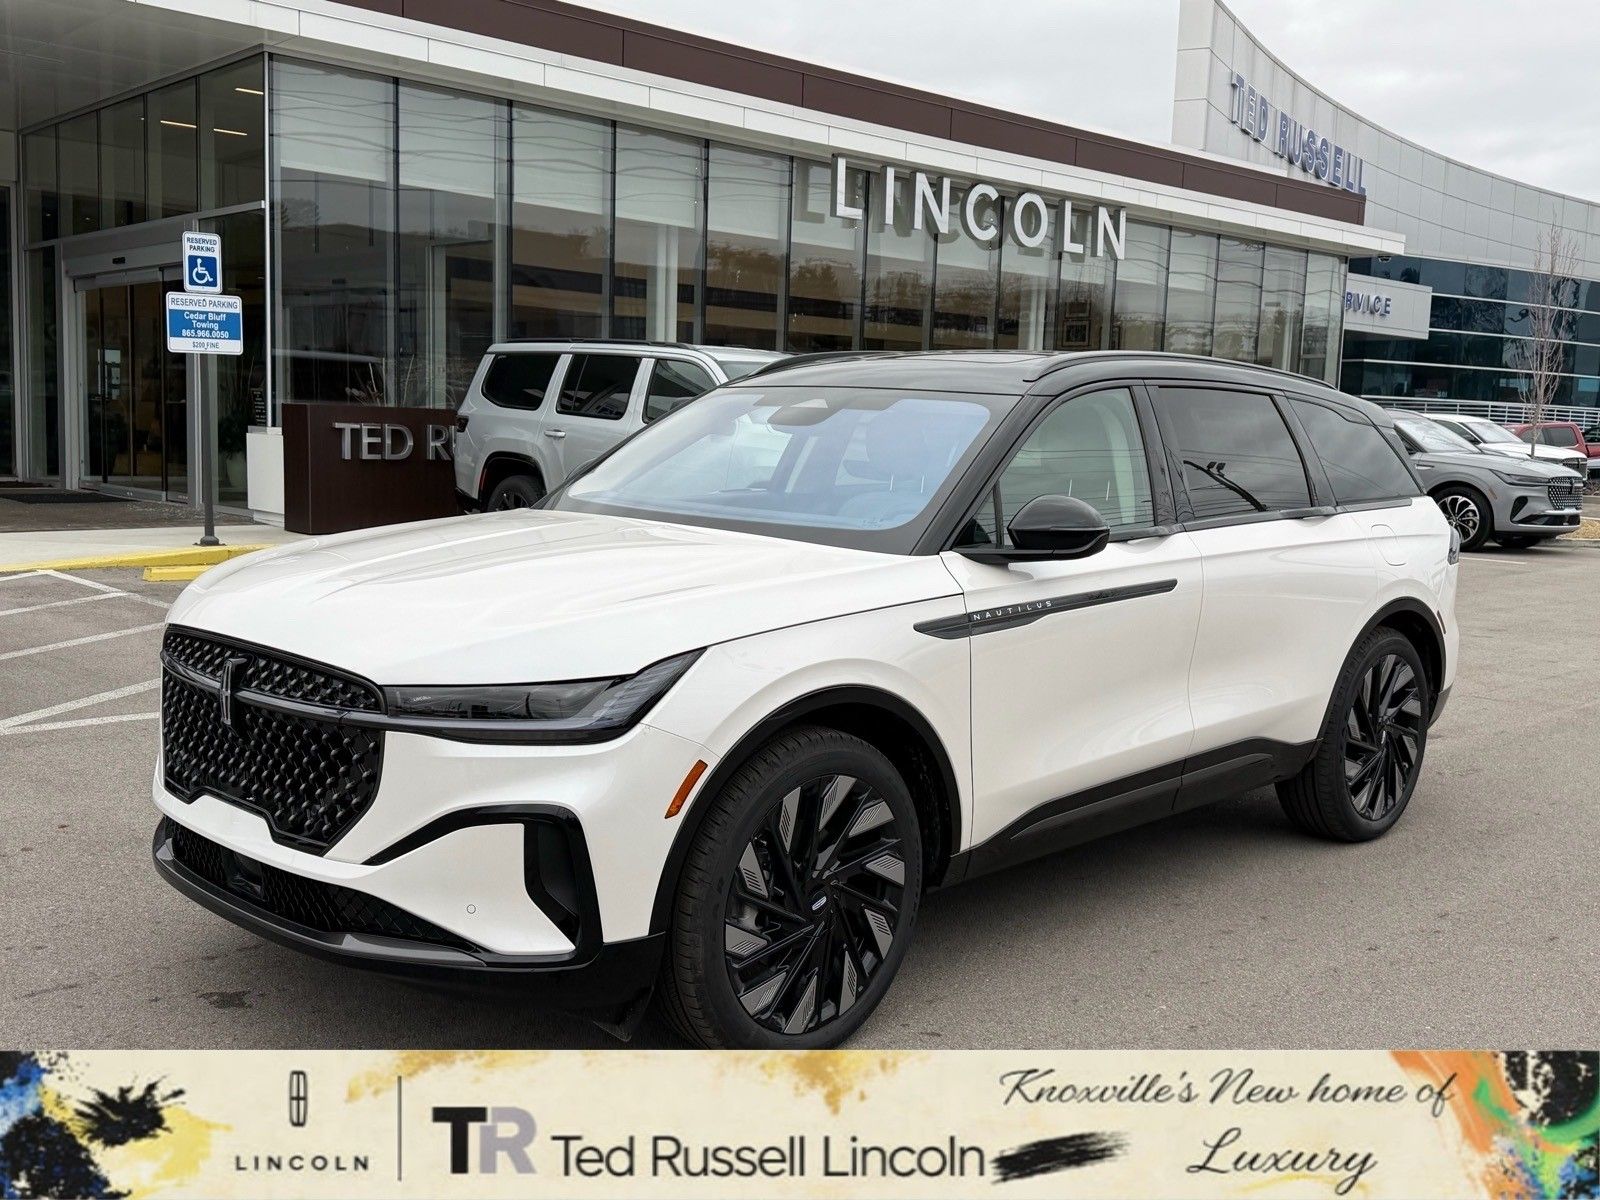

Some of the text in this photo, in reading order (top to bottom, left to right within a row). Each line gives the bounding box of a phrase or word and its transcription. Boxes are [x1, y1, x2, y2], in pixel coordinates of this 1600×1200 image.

[1231, 72, 1367, 196] TED RUSSELL
[830, 153, 1127, 260] LINCOLN
[186, 237, 217, 246] RESERVED
[189, 245, 216, 253] PARKING
[170, 297, 238, 310] RESERVED PARKING
[183, 311, 227, 321] Cedar Bluff
[191, 320, 219, 330] Towing
[207, 341, 220, 349] FINE
[332, 422, 414, 461] TED
[973, 600, 1052, 621] NAUTILUS
